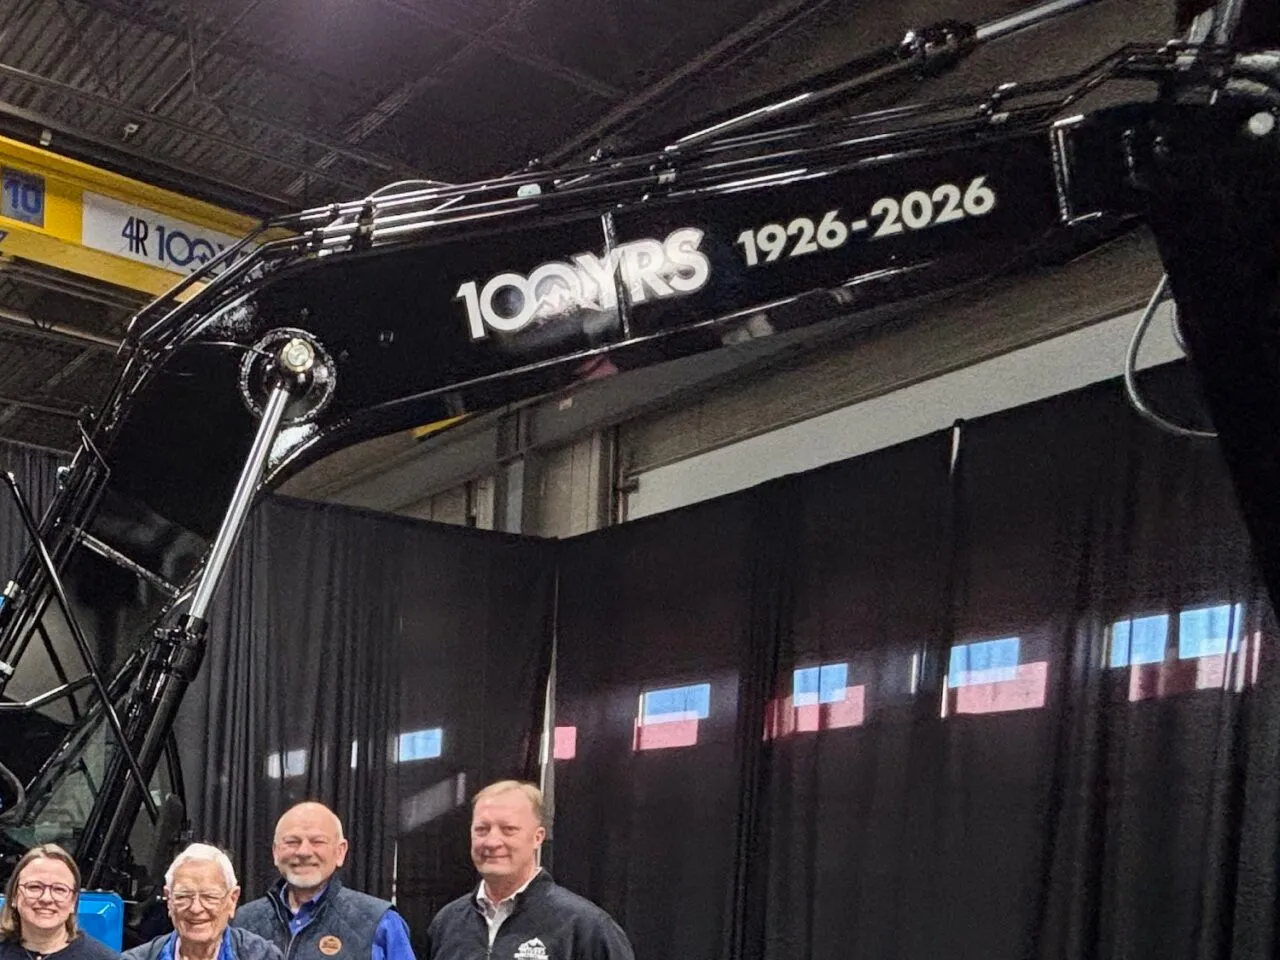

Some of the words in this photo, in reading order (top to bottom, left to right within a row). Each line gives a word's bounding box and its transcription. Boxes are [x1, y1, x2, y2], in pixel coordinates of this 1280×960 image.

[4, 178, 43, 215] 10
[736, 175, 997, 267] 1926-2026
[122, 215, 149, 256] 4R
[455, 227, 711, 340] 100YRS
